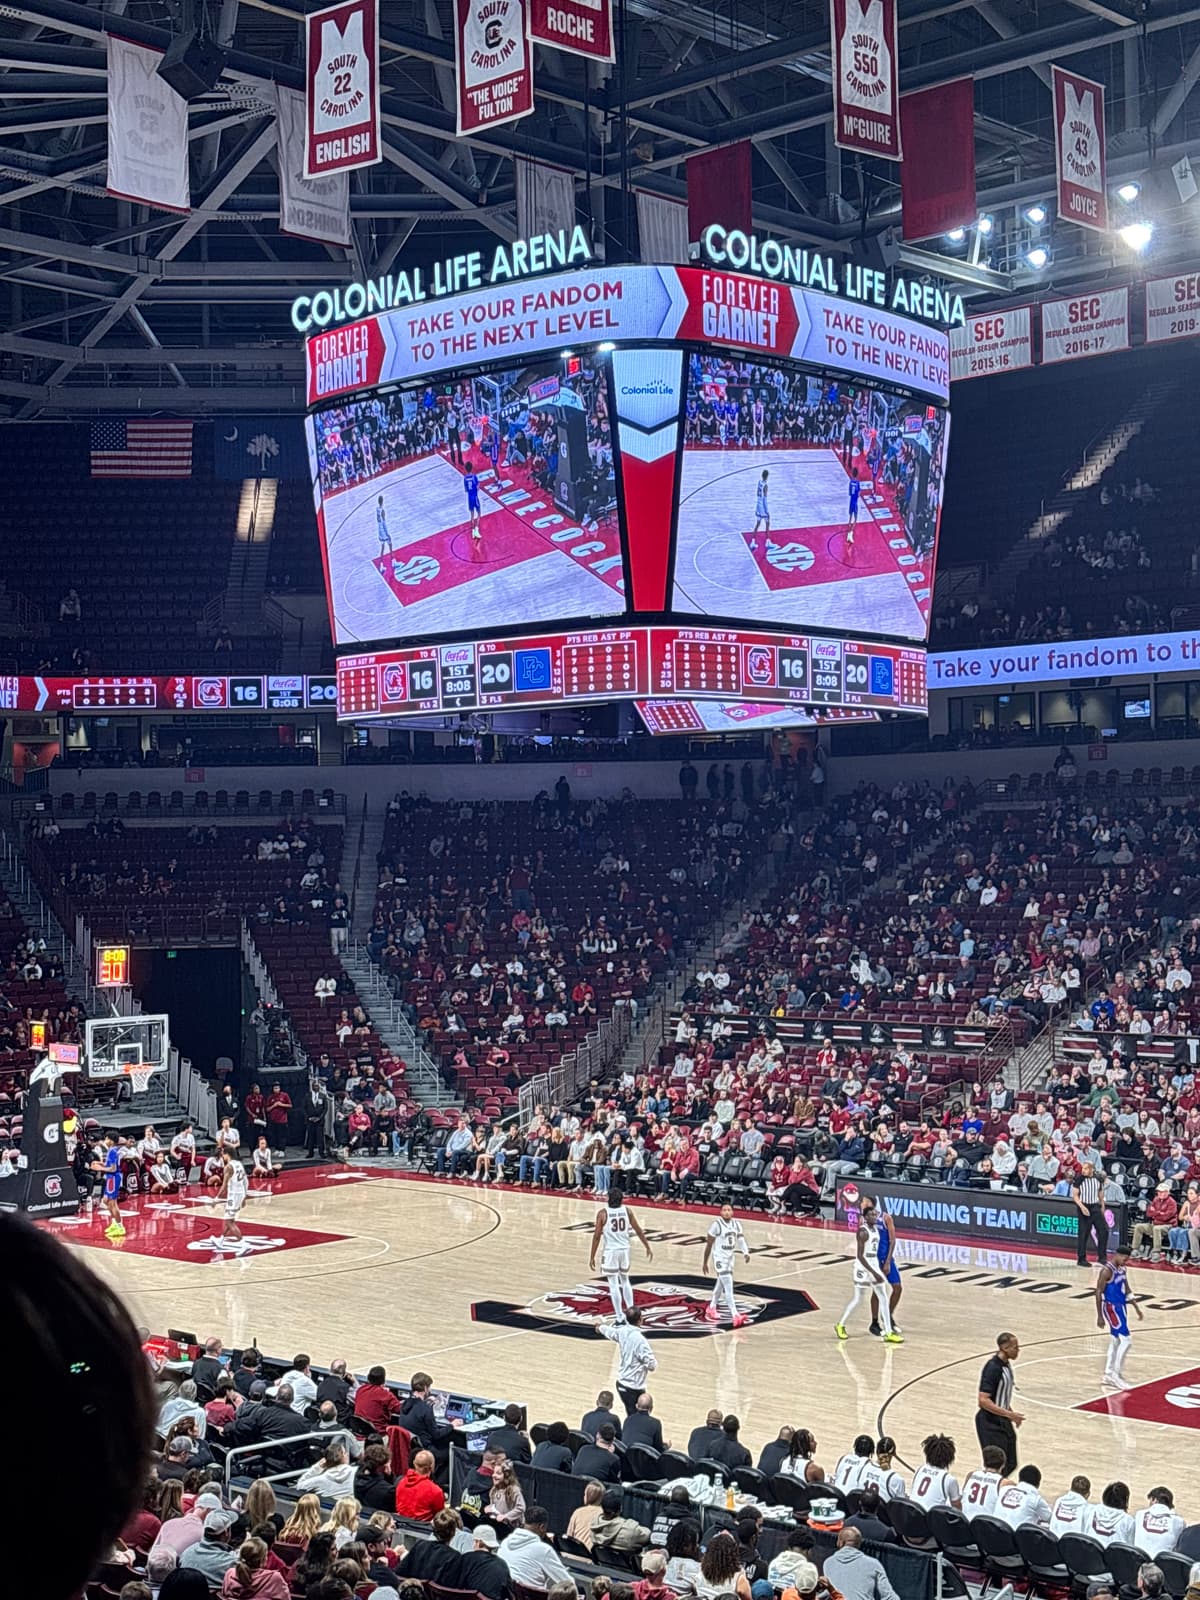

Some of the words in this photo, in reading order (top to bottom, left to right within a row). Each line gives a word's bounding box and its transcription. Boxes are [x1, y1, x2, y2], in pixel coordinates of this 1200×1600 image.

[478, 1, 509, 24] SOUTH
[546, 6, 596, 43] ROCHE
[470, 38, 517, 69] CAROLINA
[851, 34, 880, 55] SOUTH
[327, 54, 358, 76] SOUTH
[853, 51, 878, 77] 550
[333, 72, 352, 96] 22
[466, 88, 490, 106] "THE
[492, 75, 524, 101] VOICE"
[846, 71, 888, 98] CAROLINA
[320, 90, 365, 118] CAROLINA
[478, 95, 513, 120] FULTON
[842, 115, 892, 145] McGUIRE
[1070, 120, 1092, 139] SOUTH
[316, 132, 370, 165] ENGLISH
[1074, 136, 1089, 158] 43
[1066, 152, 1098, 178] CAROLINA
[1068, 192, 1098, 219] JOYCE
[290, 266, 426, 332] COLONIAL
[434, 250, 482, 298] LIFE
[490, 224, 592, 282] ARENA
[704, 222, 839, 292] COLONIAL
[846, 262, 887, 306] LIFE
[892, 277, 966, 327] ARENA
[702, 274, 780, 315] FOREVER
[408, 317, 454, 338] TAKE
[459, 299, 516, 323] YOUR
[522, 281, 623, 309] FANDOM
[1068, 297, 1100, 324] SEC
[411, 343, 435, 364] TO
[440, 333, 478, 355] THE
[482, 320, 538, 346] NEXT
[545, 308, 620, 337] LEVEL
[702, 301, 780, 349] GARNET
[822, 308, 865, 337] TAKE
[868, 322, 906, 350] YOUR
[910, 334, 948, 362] FANDO
[974, 318, 1004, 342] SEC
[315, 325, 370, 359] FOREVER
[1066, 336, 1105, 354] 2016-17
[825, 335, 848, 356] TO
[852, 342, 882, 367] THE
[884, 350, 920, 378] NEXT
[971, 354, 1009, 372] 2015-16
[316, 350, 370, 396] GARNET
[621, 386, 658, 395] Colonial
[660, 386, 674, 395] Life
[566, 636, 580, 644] PTS
[582, 634, 598, 642] REB
[620, 632, 631, 640] PF
[694, 632, 709, 640] REB
[730, 646, 736, 654] 0
[932, 657, 980, 678] Take
[989, 656, 1040, 678] your
[1047, 646, 1138, 670] fandom
[1146, 643, 1172, 662] to
[1181, 638, 1200, 660] th
[448, 665, 469, 676] 1ST
[482, 663, 510, 684] 20
[623, 672, 630, 680] 0
[782, 659, 803, 678] 16
[818, 660, 836, 670] 1ST
[846, 664, 867, 684] 20
[412, 670, 433, 690] 16
[446, 680, 471, 692] 8:08
[816, 675, 838, 687] 8:08
[234, 686, 258, 700] 16
[272, 699, 299, 708] 8:08
[310, 685, 337, 700] 20
[490, 696, 502, 704] FLS
[802, 690, 808, 698] 2
[420, 701, 430, 709] FLS
[104, 950, 126, 961] 8:08
[884, 1196, 970, 1224] WINNING
[974, 1206, 1026, 1230] TEAM
[611, 1217, 625, 1232] 30
[842, 1466, 852, 1486] 1
[917, 1476, 931, 1496] 0
[968, 1482, 988, 1506] 31
